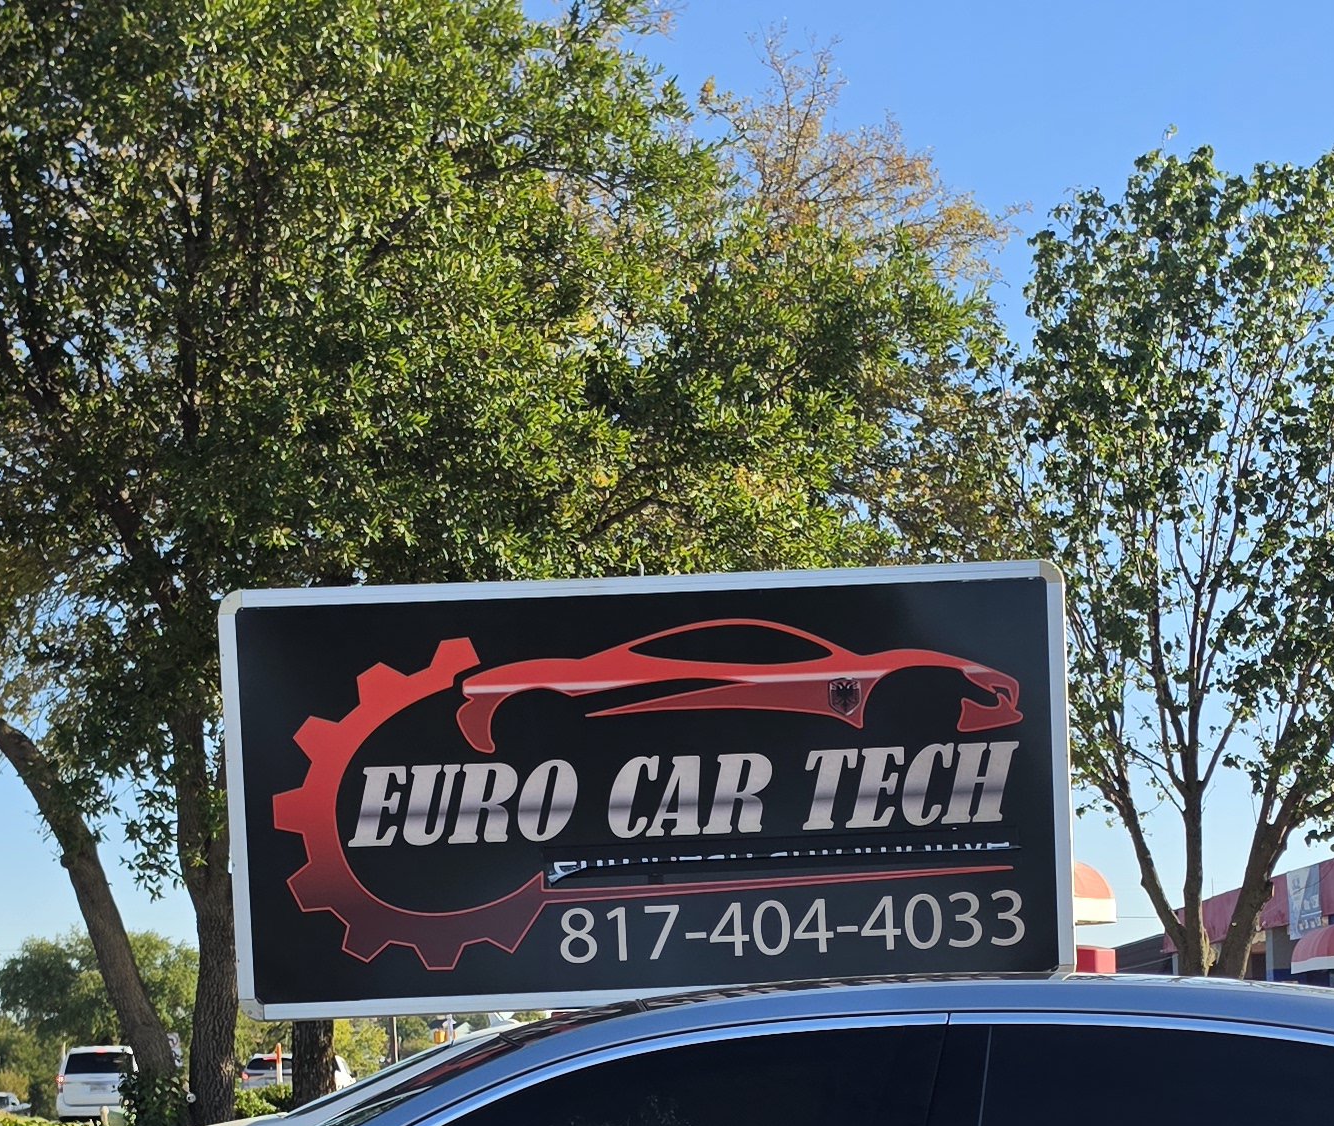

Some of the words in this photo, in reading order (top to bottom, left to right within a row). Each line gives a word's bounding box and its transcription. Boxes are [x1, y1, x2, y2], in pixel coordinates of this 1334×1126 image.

[347, 759, 578, 848] EURO
[607, 753, 773, 839] CAR
[802, 741, 1020, 831] TECH
[559, 888, 1026, 965] 817-404-4033
